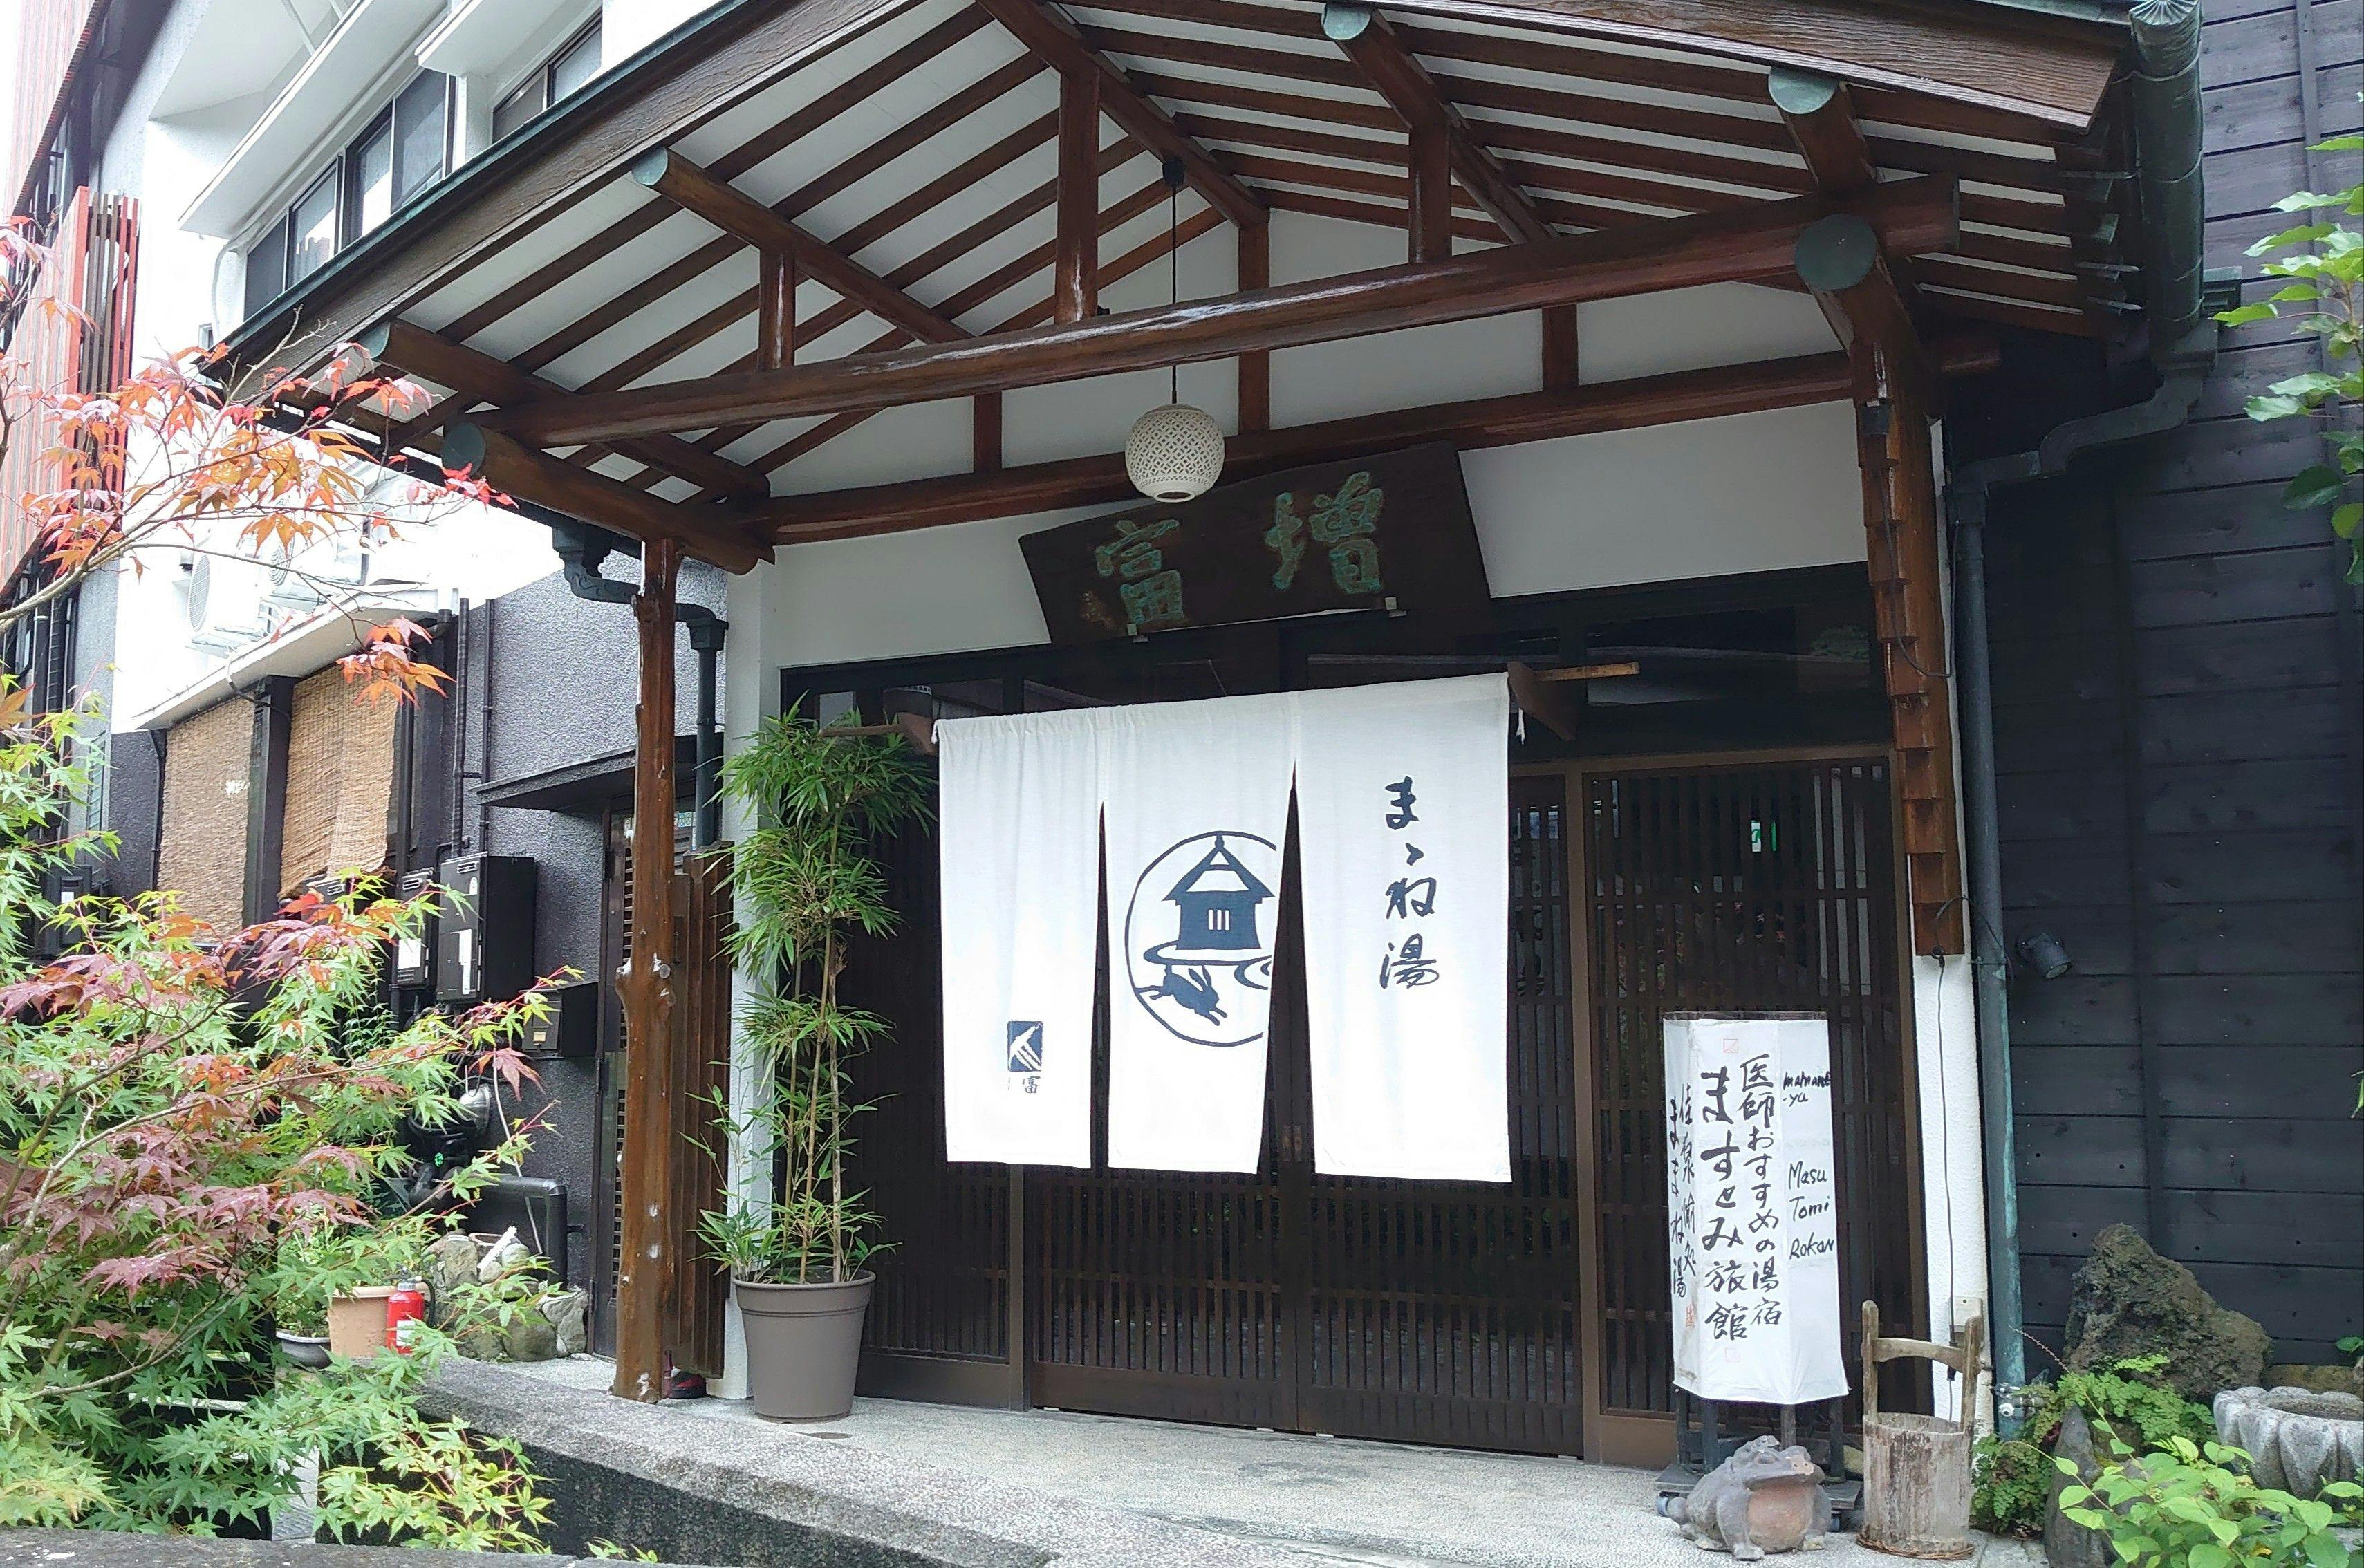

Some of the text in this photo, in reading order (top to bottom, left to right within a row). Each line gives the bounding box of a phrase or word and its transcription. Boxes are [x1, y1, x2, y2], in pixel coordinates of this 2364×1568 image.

[1700, 1065, 1748, 1341] ますとみ旅館
[1738, 1053, 1782, 1326] 医師おすすめの湯宿
[1789, 1161, 1827, 1190] Masu
[1789, 1195, 1830, 1222] Tomi
